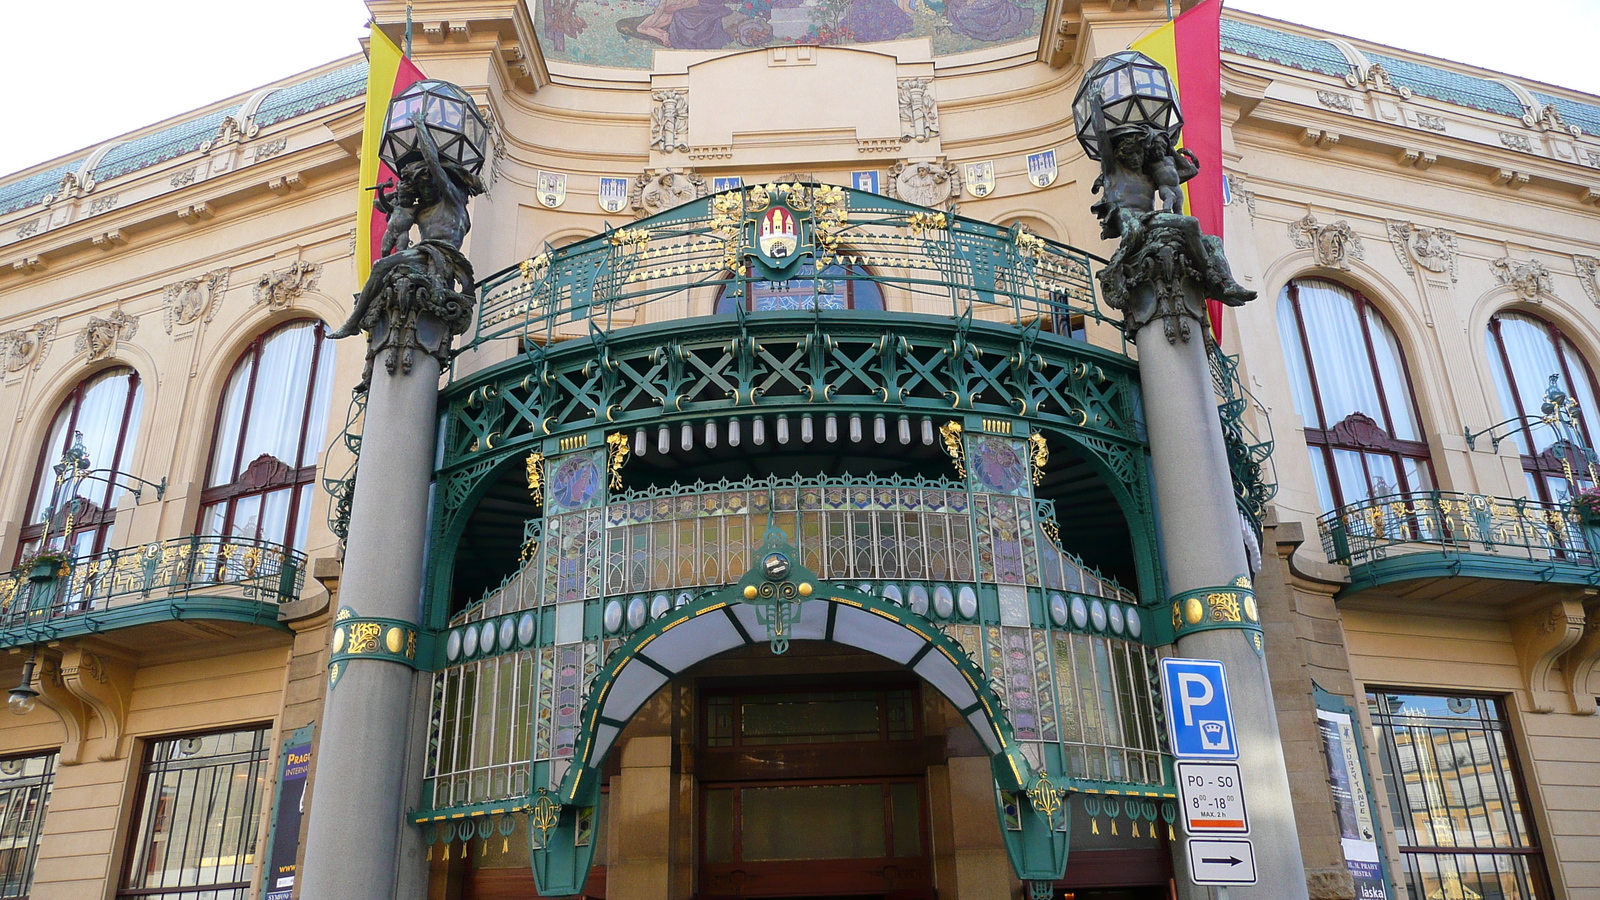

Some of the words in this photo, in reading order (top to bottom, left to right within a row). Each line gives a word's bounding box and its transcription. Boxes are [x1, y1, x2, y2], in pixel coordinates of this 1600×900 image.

[1178, 672, 1214, 726] P
[1187, 775, 1204, 787] PO
[1217, 776, 1233, 788] SO
[1345, 747, 1358, 780] KURZY
[1354, 781, 1365, 814] TANCE
